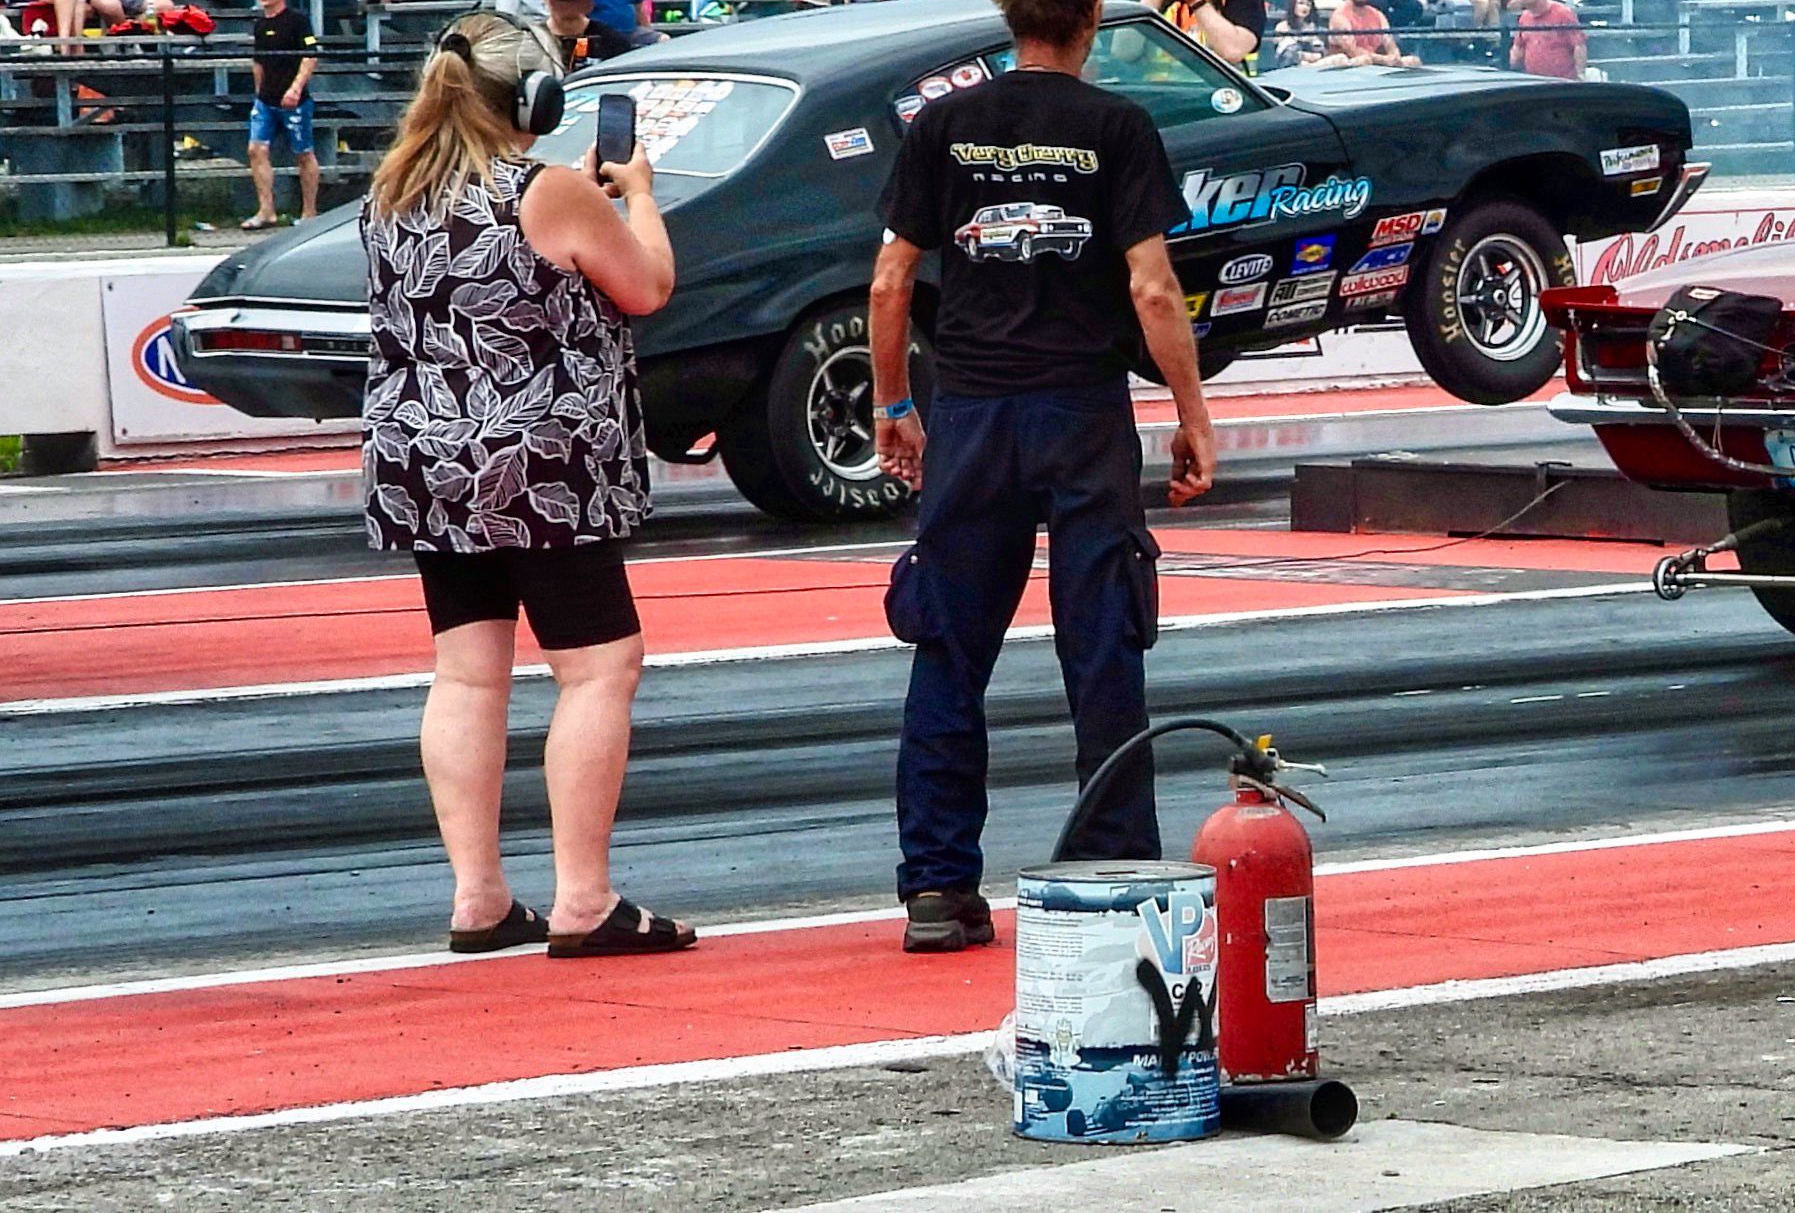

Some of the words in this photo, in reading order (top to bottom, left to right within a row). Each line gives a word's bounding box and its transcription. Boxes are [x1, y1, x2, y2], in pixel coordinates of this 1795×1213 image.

[951, 143, 1015, 170] Very
[1016, 143, 1098, 172] Cherry
[1269, 176, 1370, 219] Racing
[1377, 214, 1422, 235] MSD
[1136, 891, 1206, 975] VP
